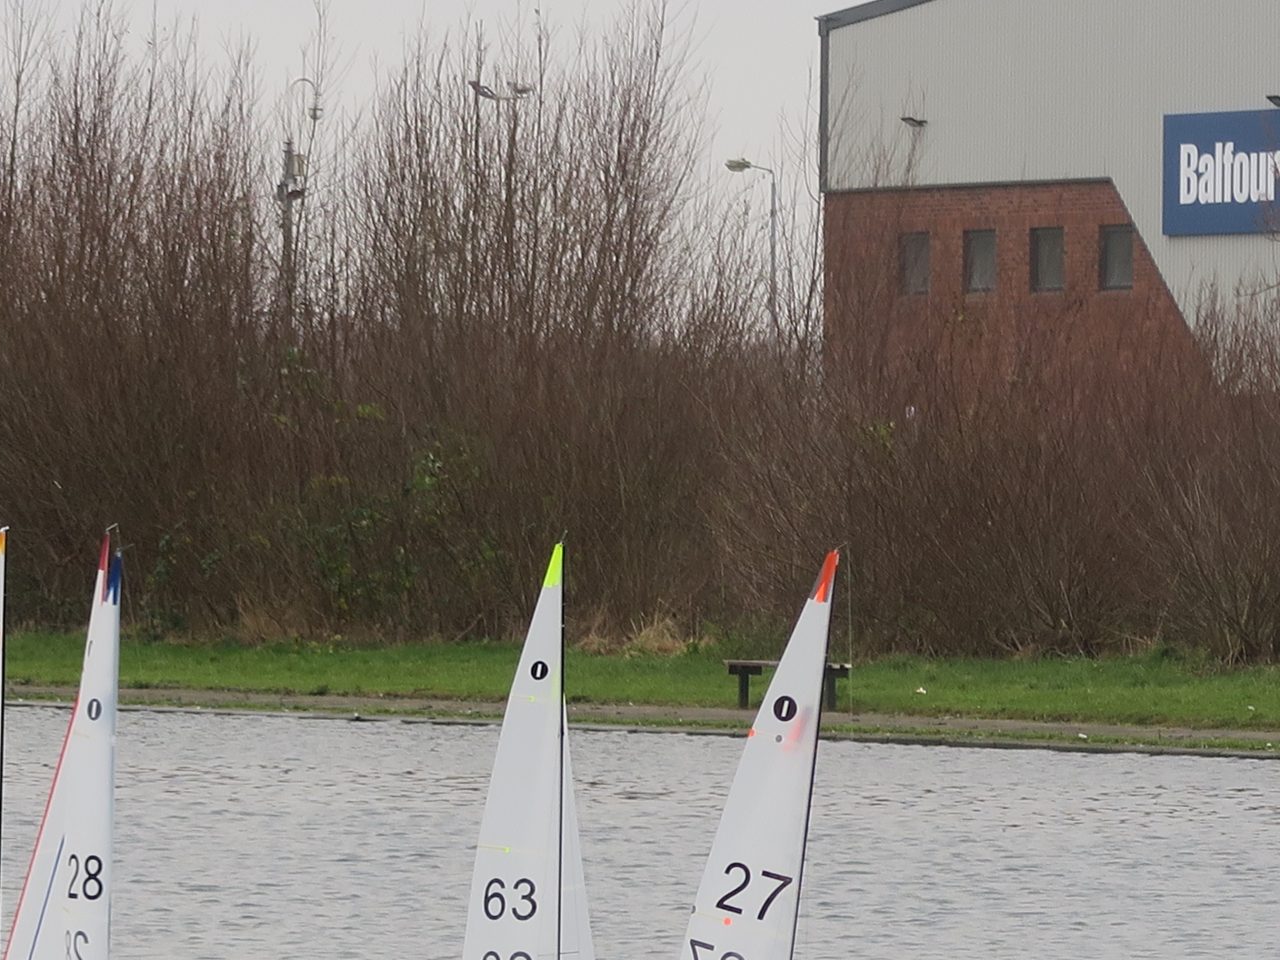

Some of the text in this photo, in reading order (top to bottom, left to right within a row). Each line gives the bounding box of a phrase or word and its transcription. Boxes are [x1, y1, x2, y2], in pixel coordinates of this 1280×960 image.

[1179, 141, 1280, 205] Balfour
[67, 853, 104, 901] 28
[483, 877, 538, 921] 63
[715, 862, 793, 921] 27
